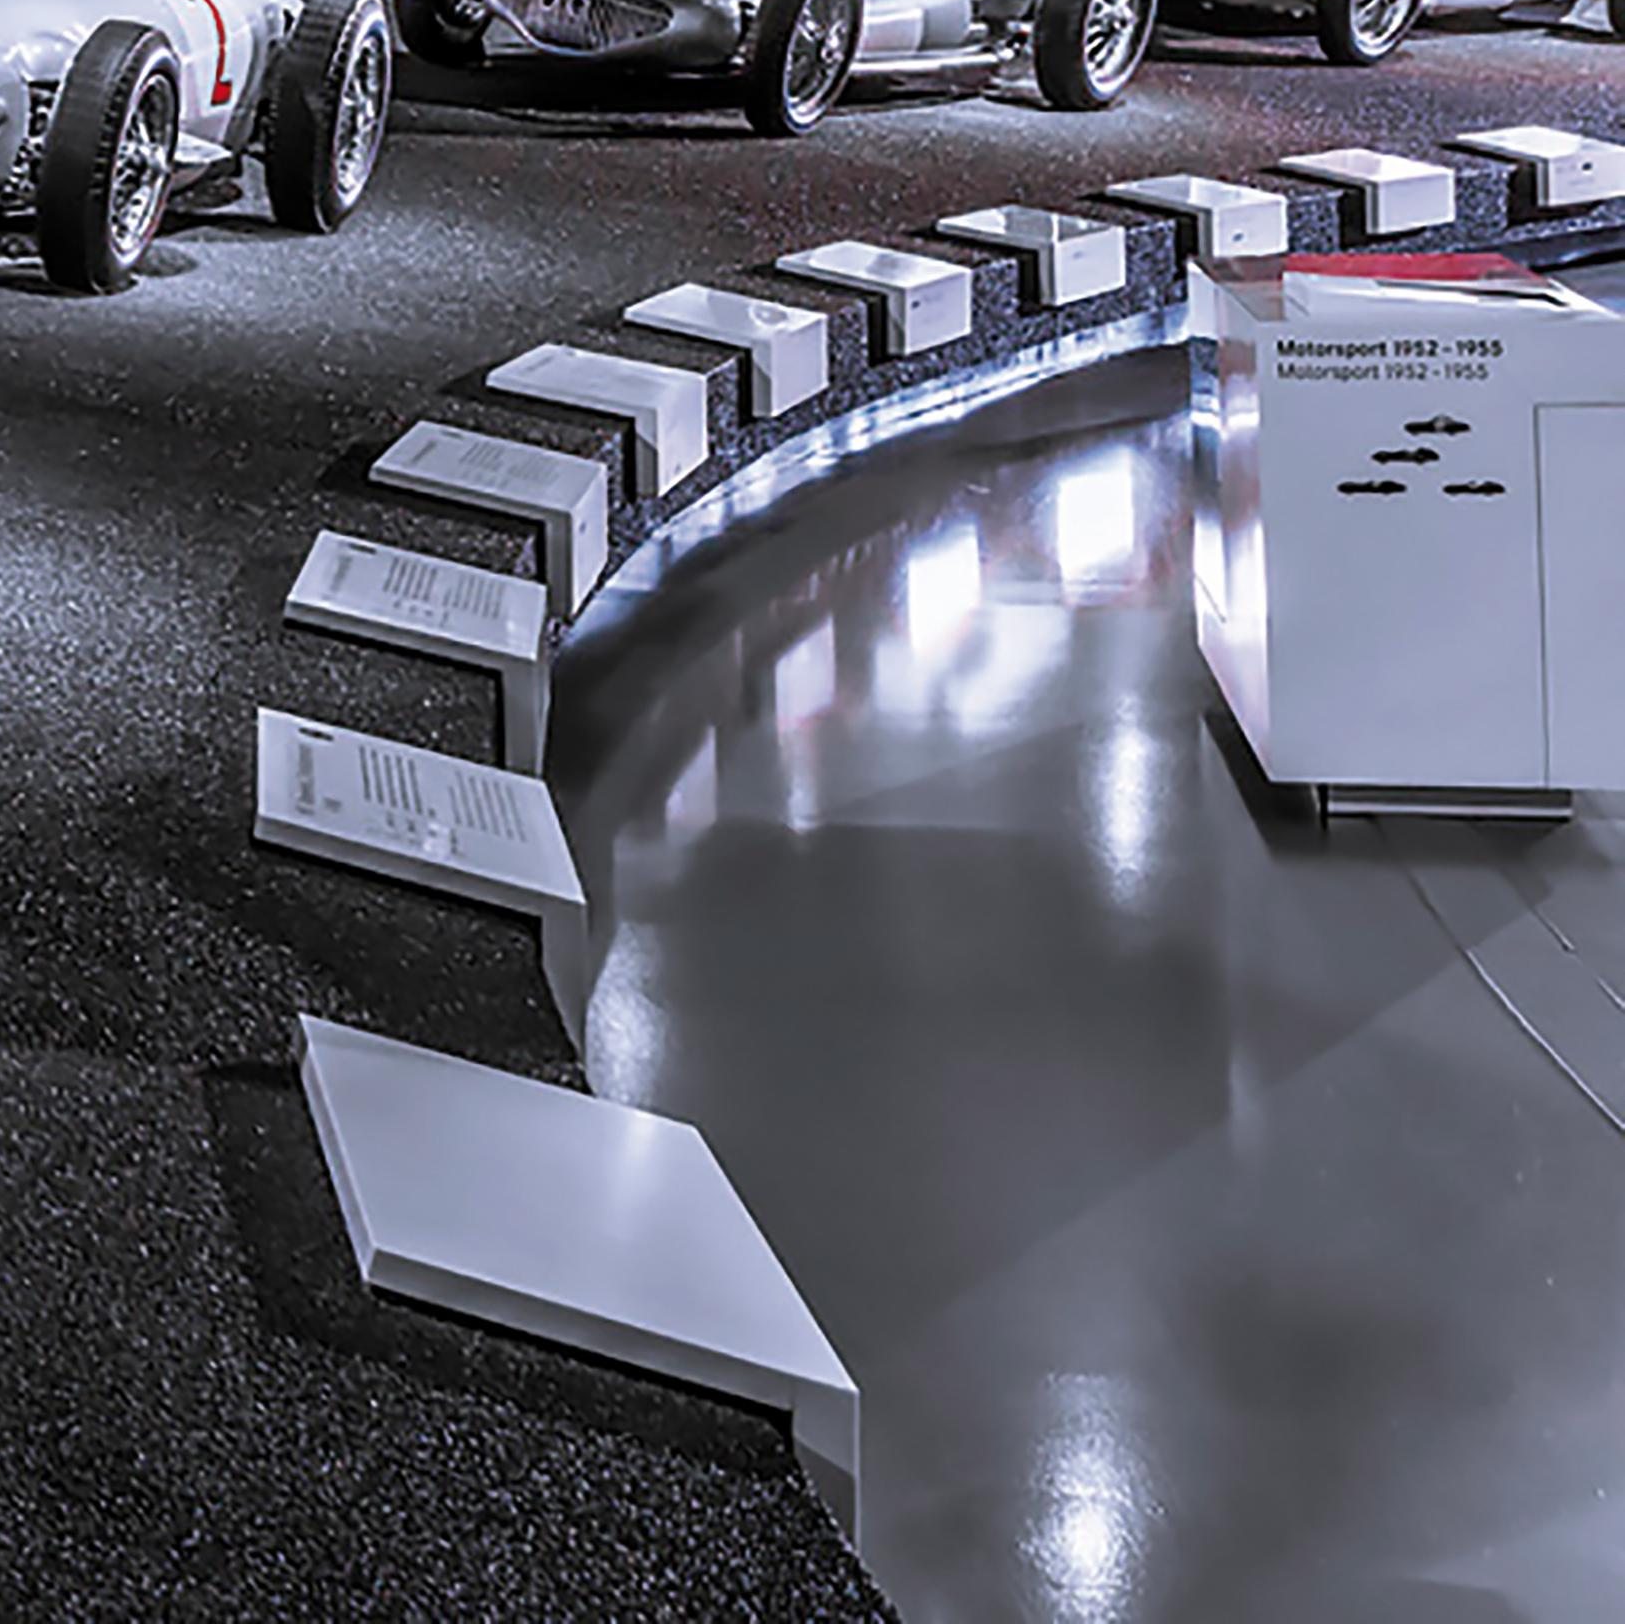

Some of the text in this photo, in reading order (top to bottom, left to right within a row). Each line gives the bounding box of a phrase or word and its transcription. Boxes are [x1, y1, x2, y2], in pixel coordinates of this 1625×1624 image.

[1276, 339, 1388, 360] Motorsport
[1392, 339, 1440, 357] 1952
[1455, 339, 1505, 357] 1955
[1276, 362, 1380, 381] Motorsport
[1385, 362, 1428, 380] 1952
[1444, 362, 1490, 380] 1955
